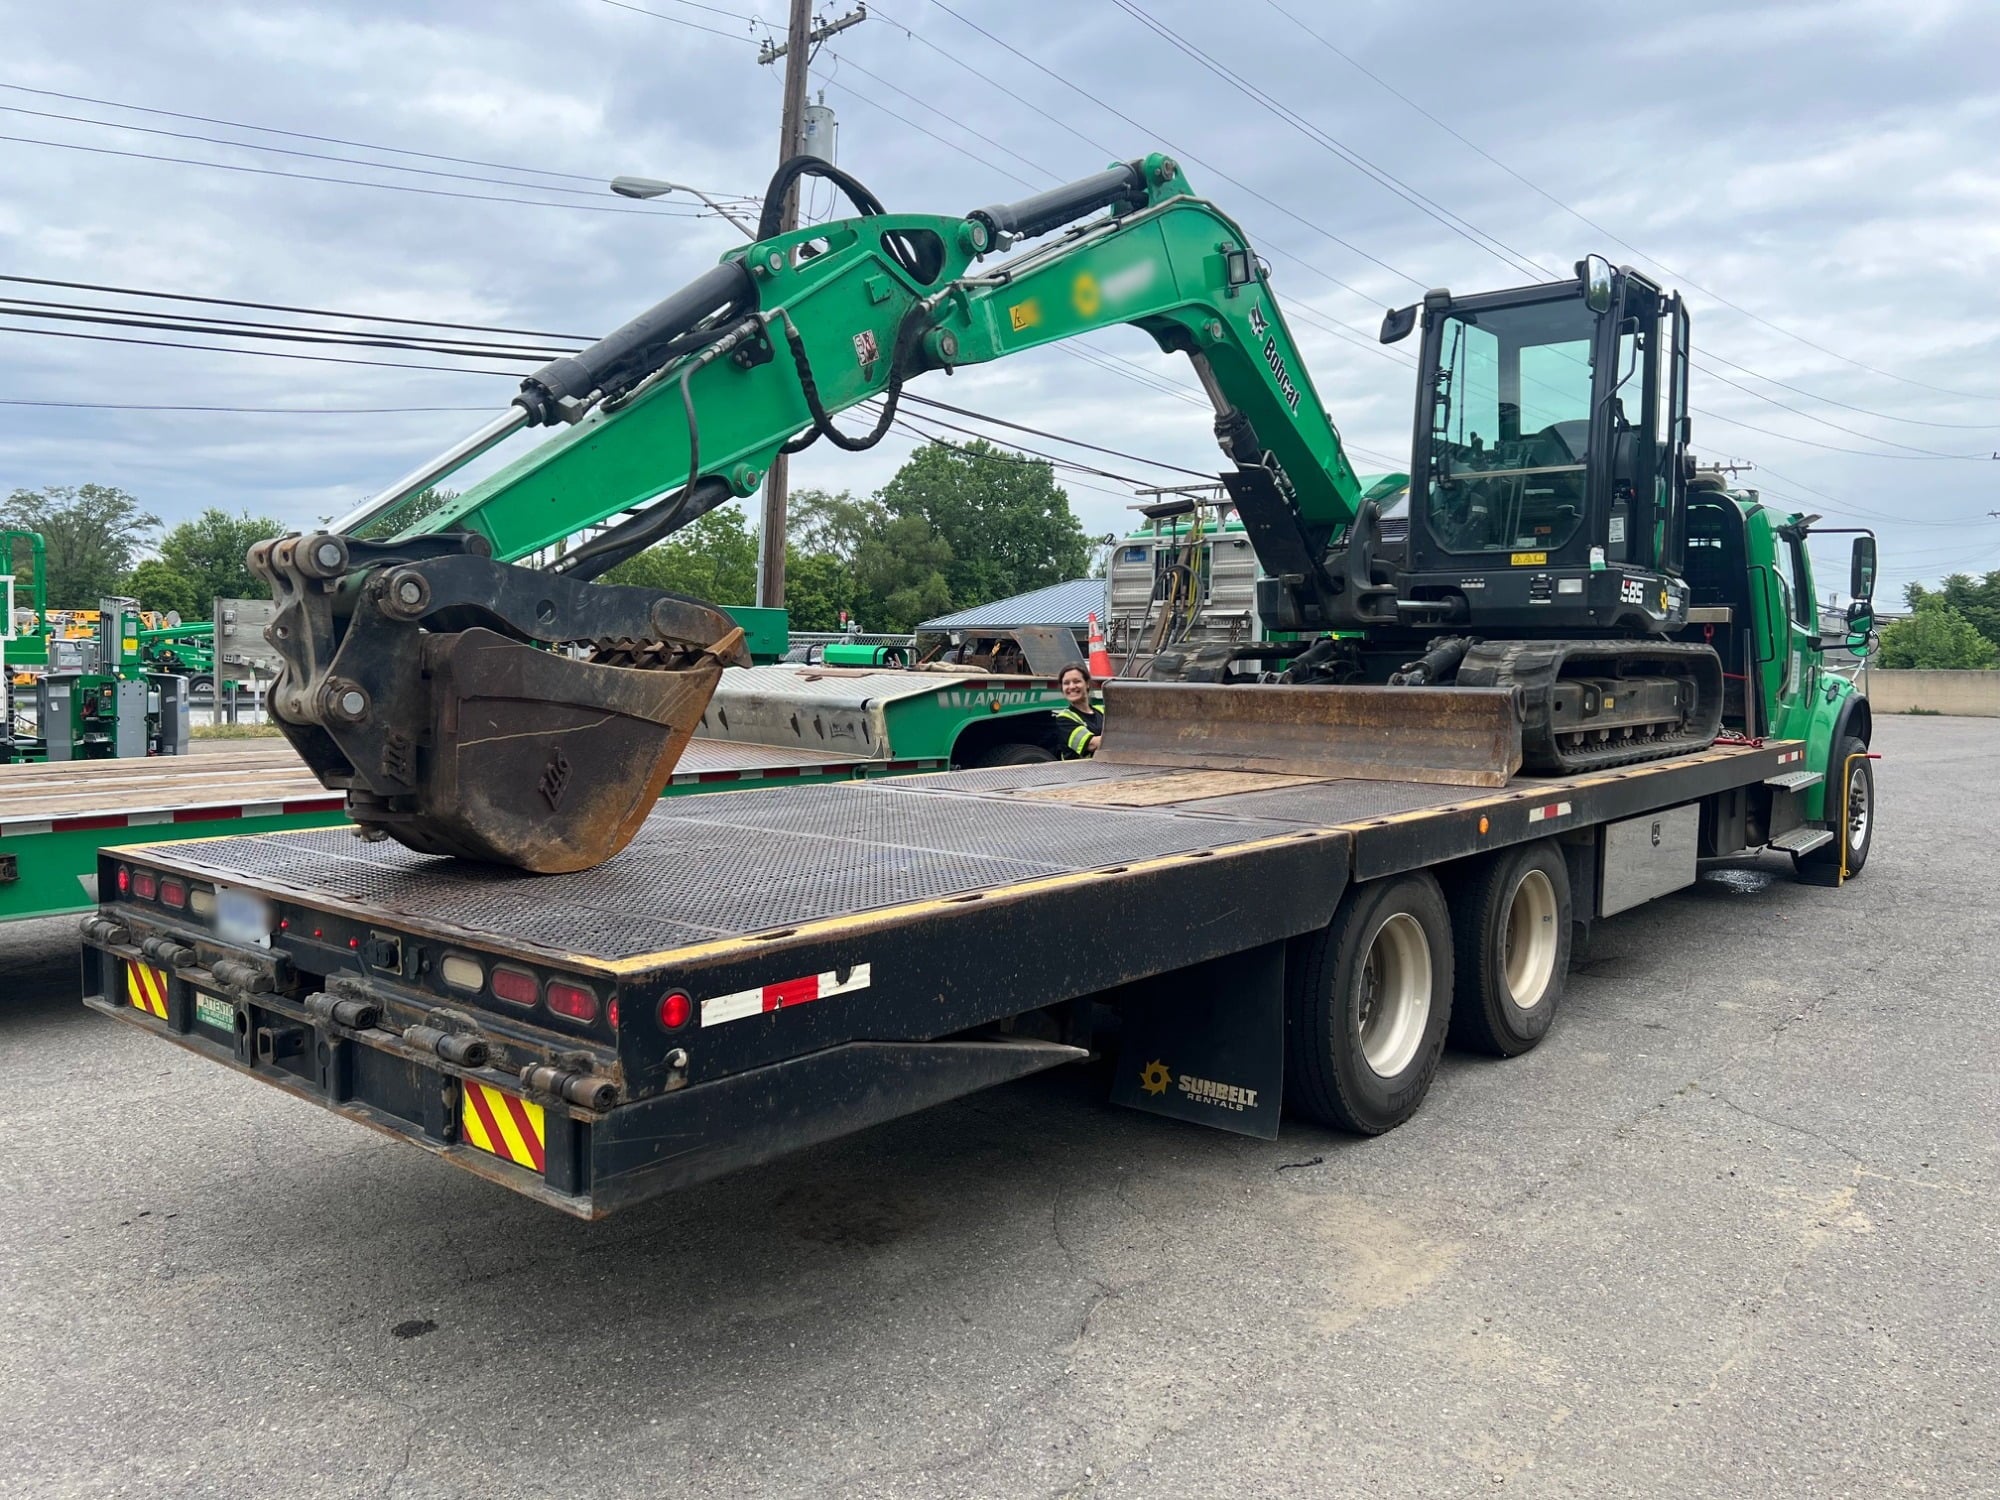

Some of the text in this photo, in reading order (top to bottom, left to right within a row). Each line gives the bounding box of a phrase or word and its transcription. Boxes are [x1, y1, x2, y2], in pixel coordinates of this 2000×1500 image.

[1264, 334, 1301, 413] Bobcat
[964, 691, 1039, 707] LANDOLL
[203, 996, 234, 1017] ATTENTIO
[1178, 1074, 1258, 1106] SUNBELT
[1186, 1093, 1244, 1111] RENTALS
